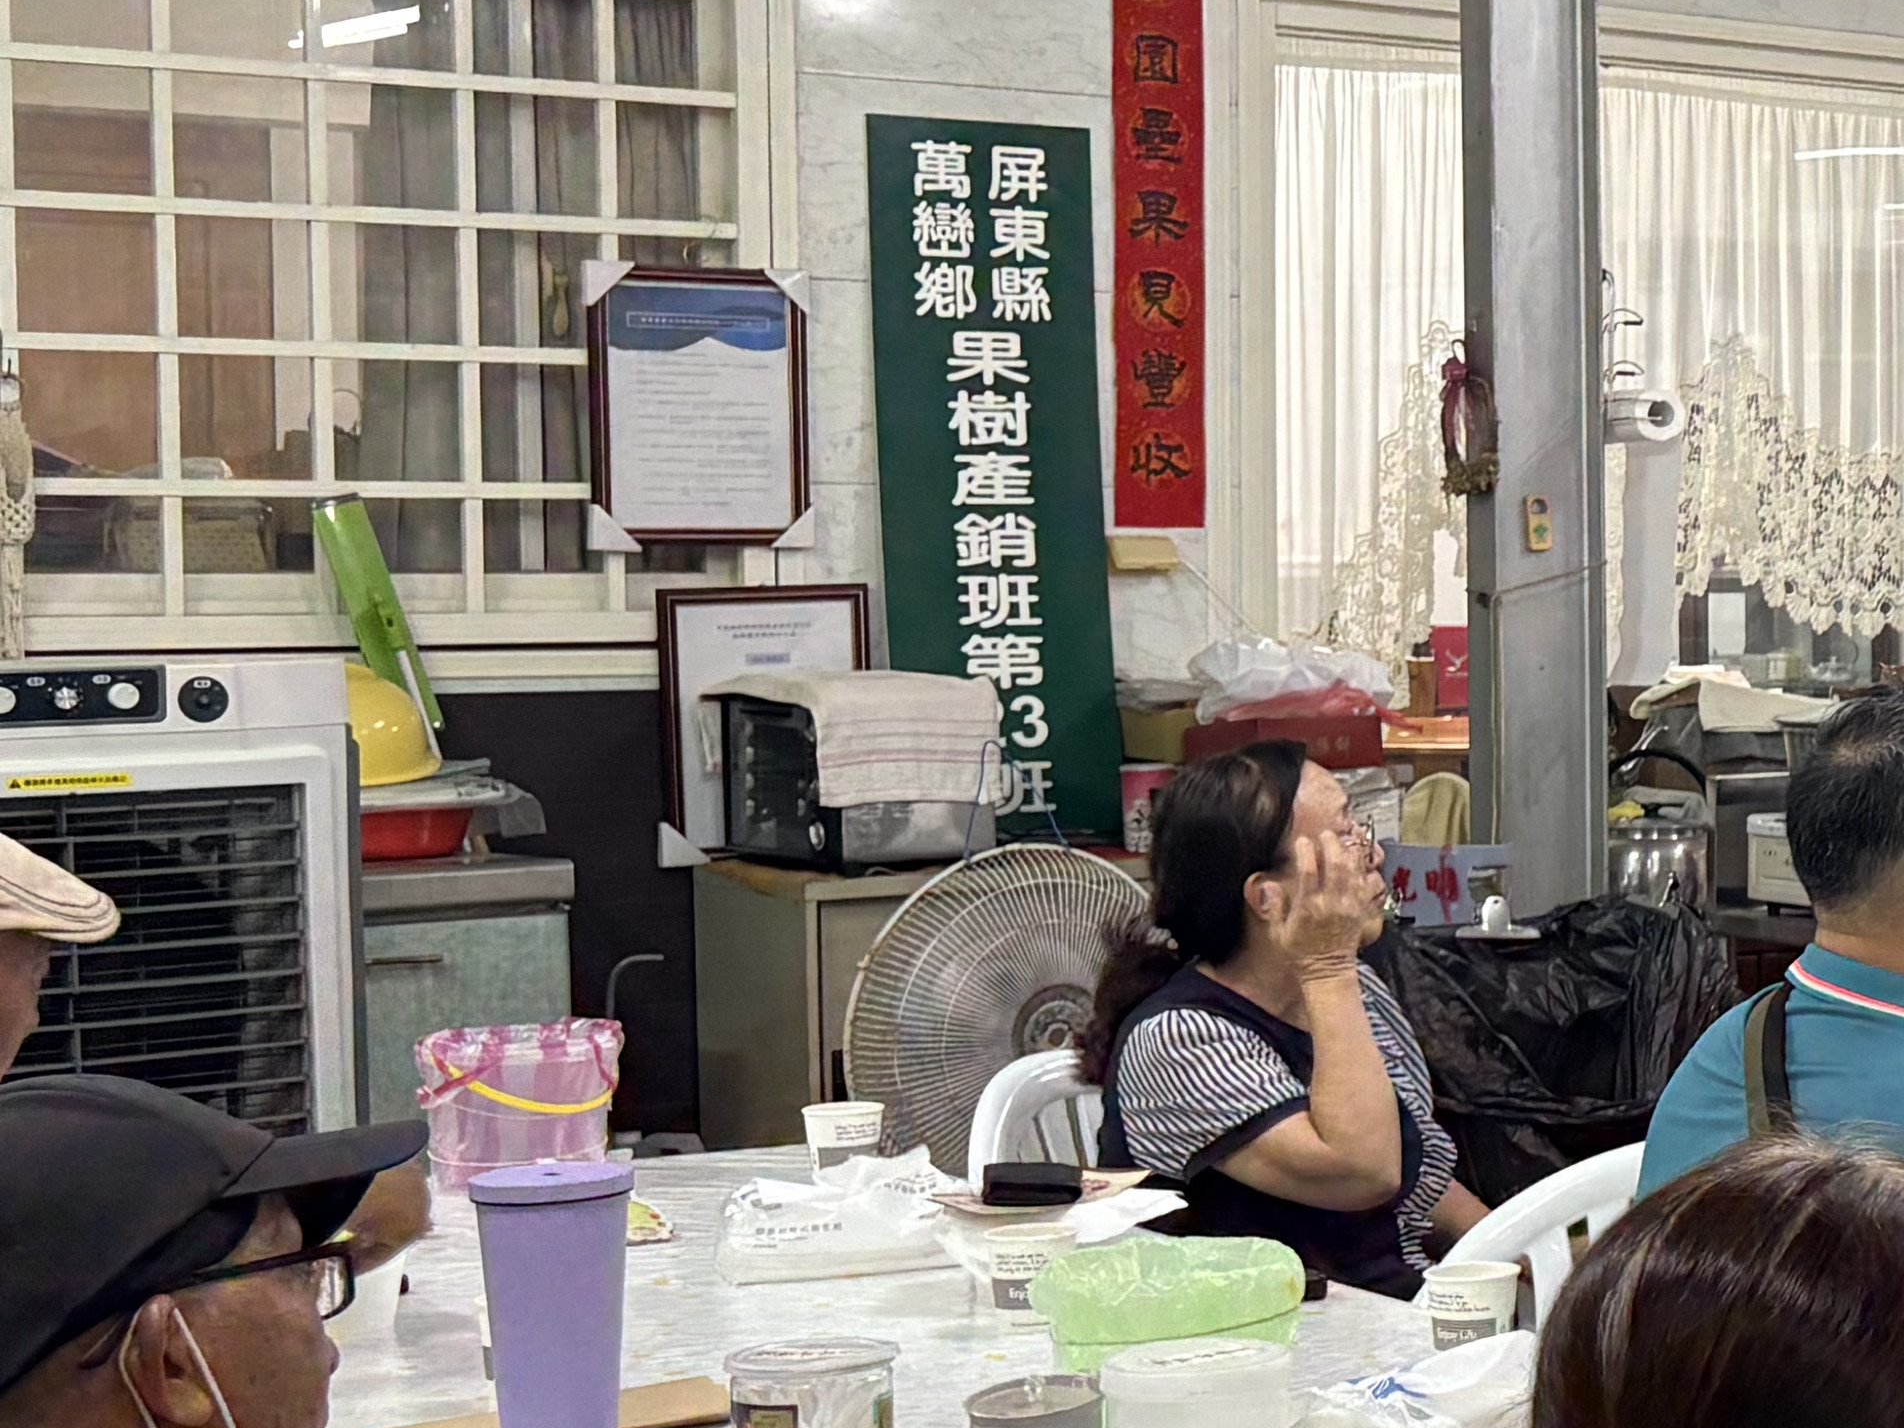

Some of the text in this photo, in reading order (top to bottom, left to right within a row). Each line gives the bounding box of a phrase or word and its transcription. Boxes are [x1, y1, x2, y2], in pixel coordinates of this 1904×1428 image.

[910, 139, 978, 320] 萬巒鄉
[987, 144, 1053, 323] 屏東縣
